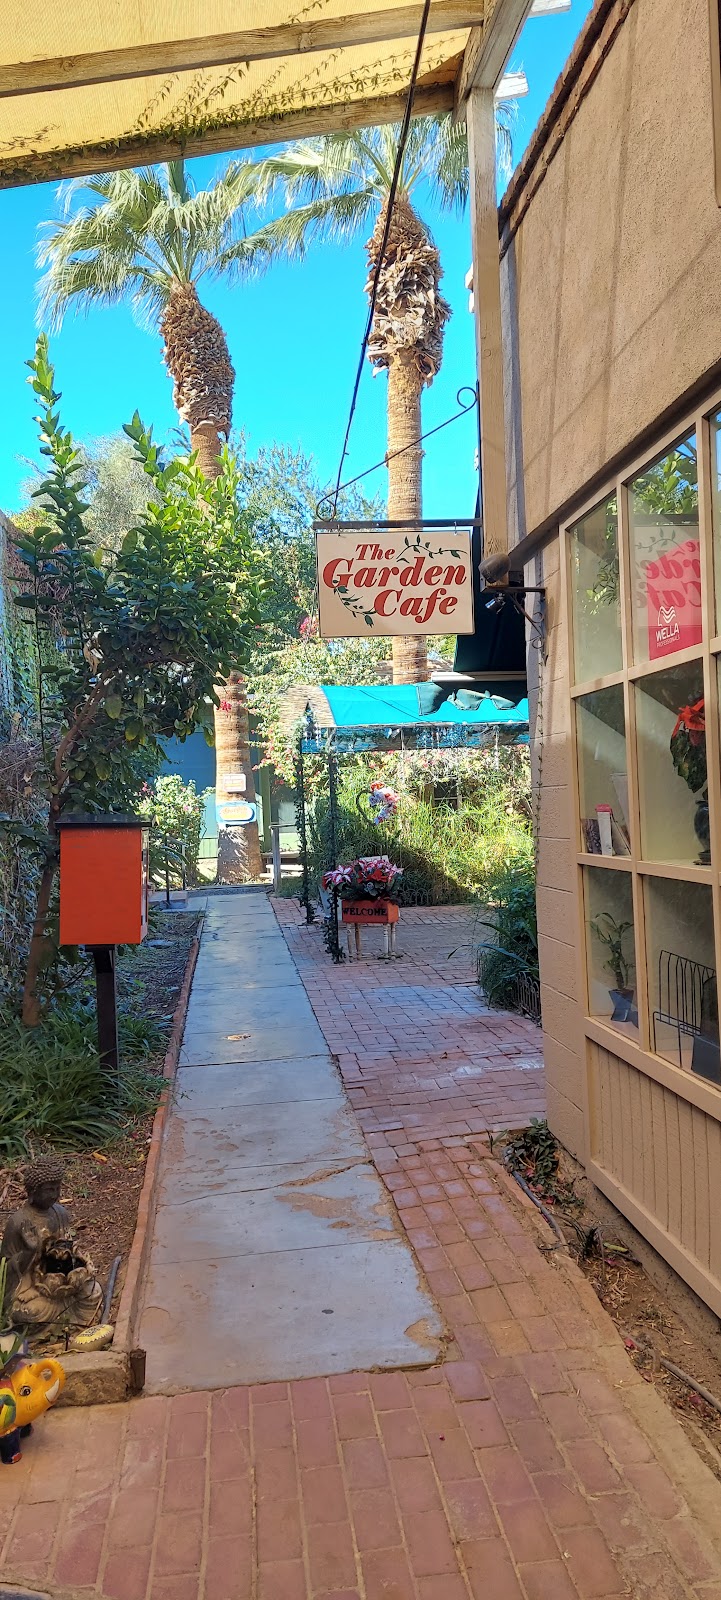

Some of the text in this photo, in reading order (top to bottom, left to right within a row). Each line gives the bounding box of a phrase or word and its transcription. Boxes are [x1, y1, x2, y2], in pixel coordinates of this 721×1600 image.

[355, 543, 395, 560] The
[322, 556, 467, 588] Garden
[373, 587, 458, 623] Cafe
[656, 623, 679, 642] WELLA
[342, 907, 386, 916] WELCOME
